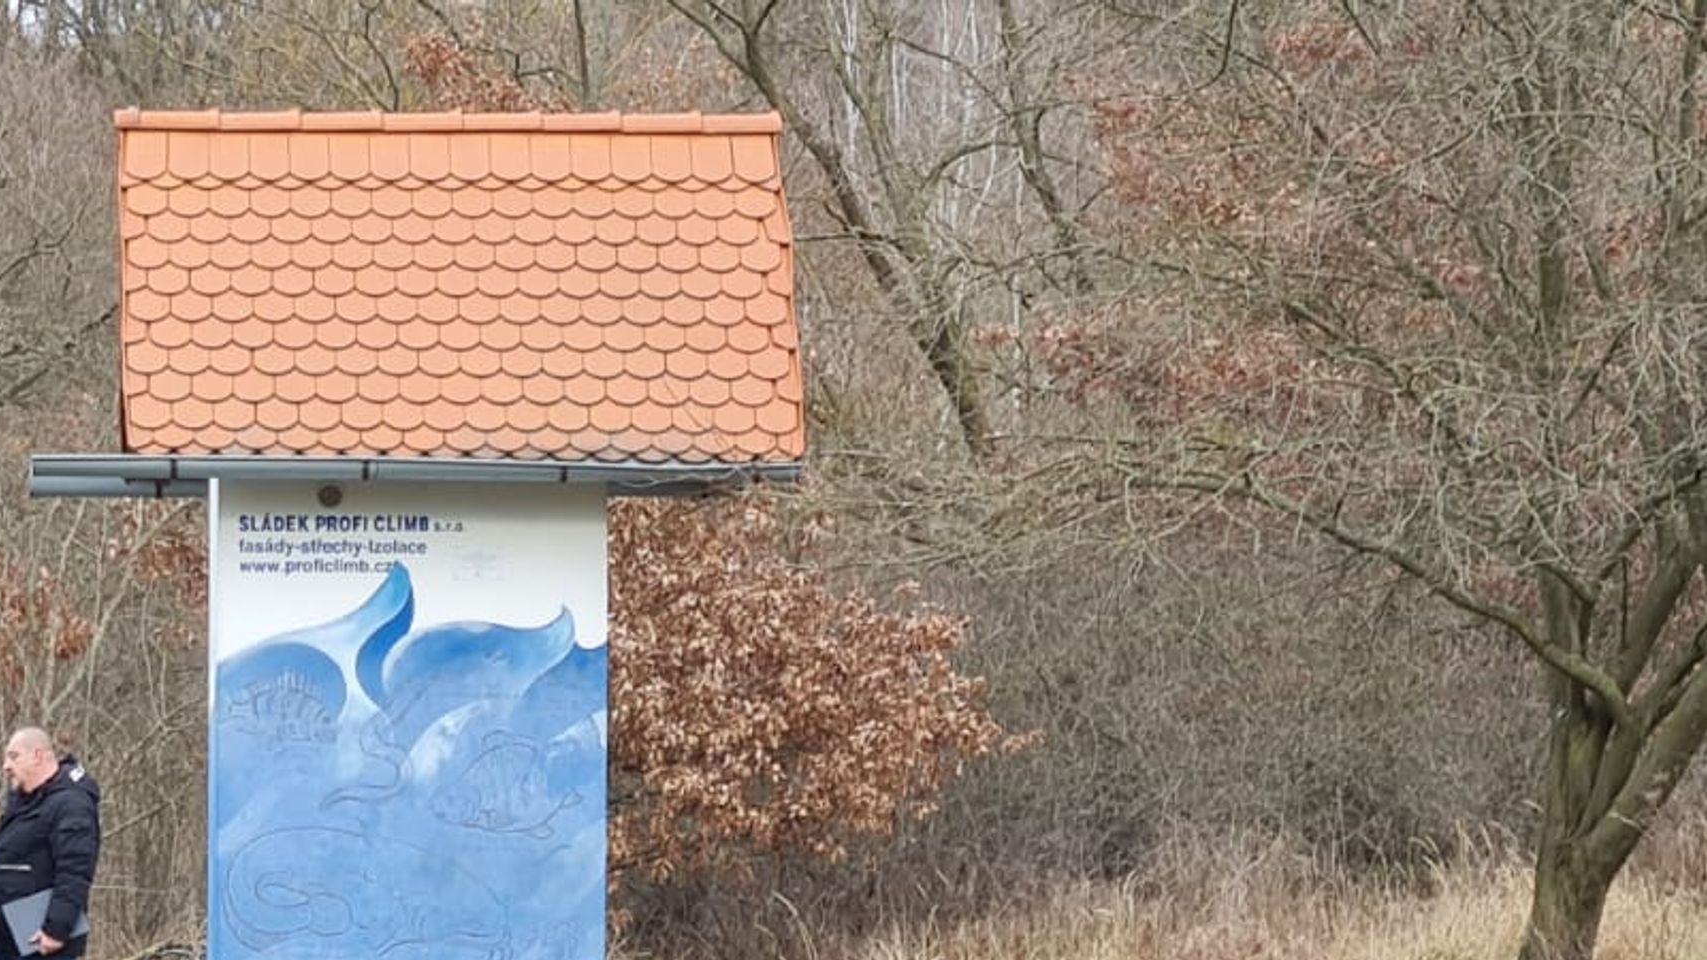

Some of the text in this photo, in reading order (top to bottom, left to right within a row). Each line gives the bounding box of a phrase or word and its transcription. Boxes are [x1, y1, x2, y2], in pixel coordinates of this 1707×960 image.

[239, 512, 309, 532] SLÁDEK
[315, 515, 368, 532] PROFI
[374, 515, 429, 532] CLIMB
[240, 558, 393, 575] www.proficlimb.cz
